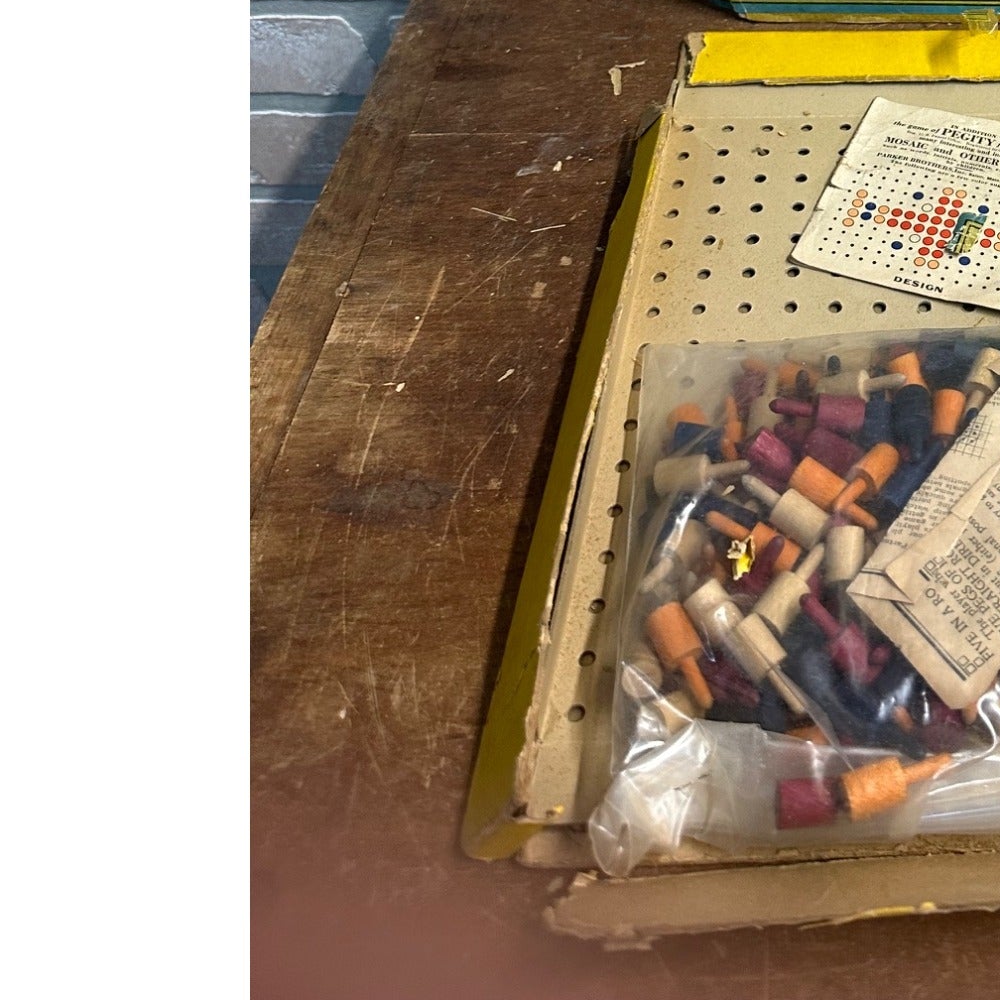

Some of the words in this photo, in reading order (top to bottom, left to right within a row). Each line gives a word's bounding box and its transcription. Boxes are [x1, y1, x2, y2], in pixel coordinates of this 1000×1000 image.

[906, 123, 929, 132] game
[940, 127, 996, 146] PEGITY
[876, 151, 909, 162] PARKER
[884, 135, 929, 150] MOSAIC
[932, 146, 953, 155] and
[958, 151, 1000, 166] OTHER
[903, 162, 936, 173] following
[892, 275, 944, 293] DESIGN
[984, 500, 994, 510] to
[966, 534, 997, 564] (either
[943, 568, 963, 585] OF
[978, 564, 992, 578] in
[922, 586, 944, 607] RO
[948, 588, 979, 618] player
[960, 583, 990, 614] PEGS
[940, 604, 954, 616] A
[949, 615, 968, 633] IN
[974, 616, 996, 641] The
[964, 630, 995, 661] FIVE
